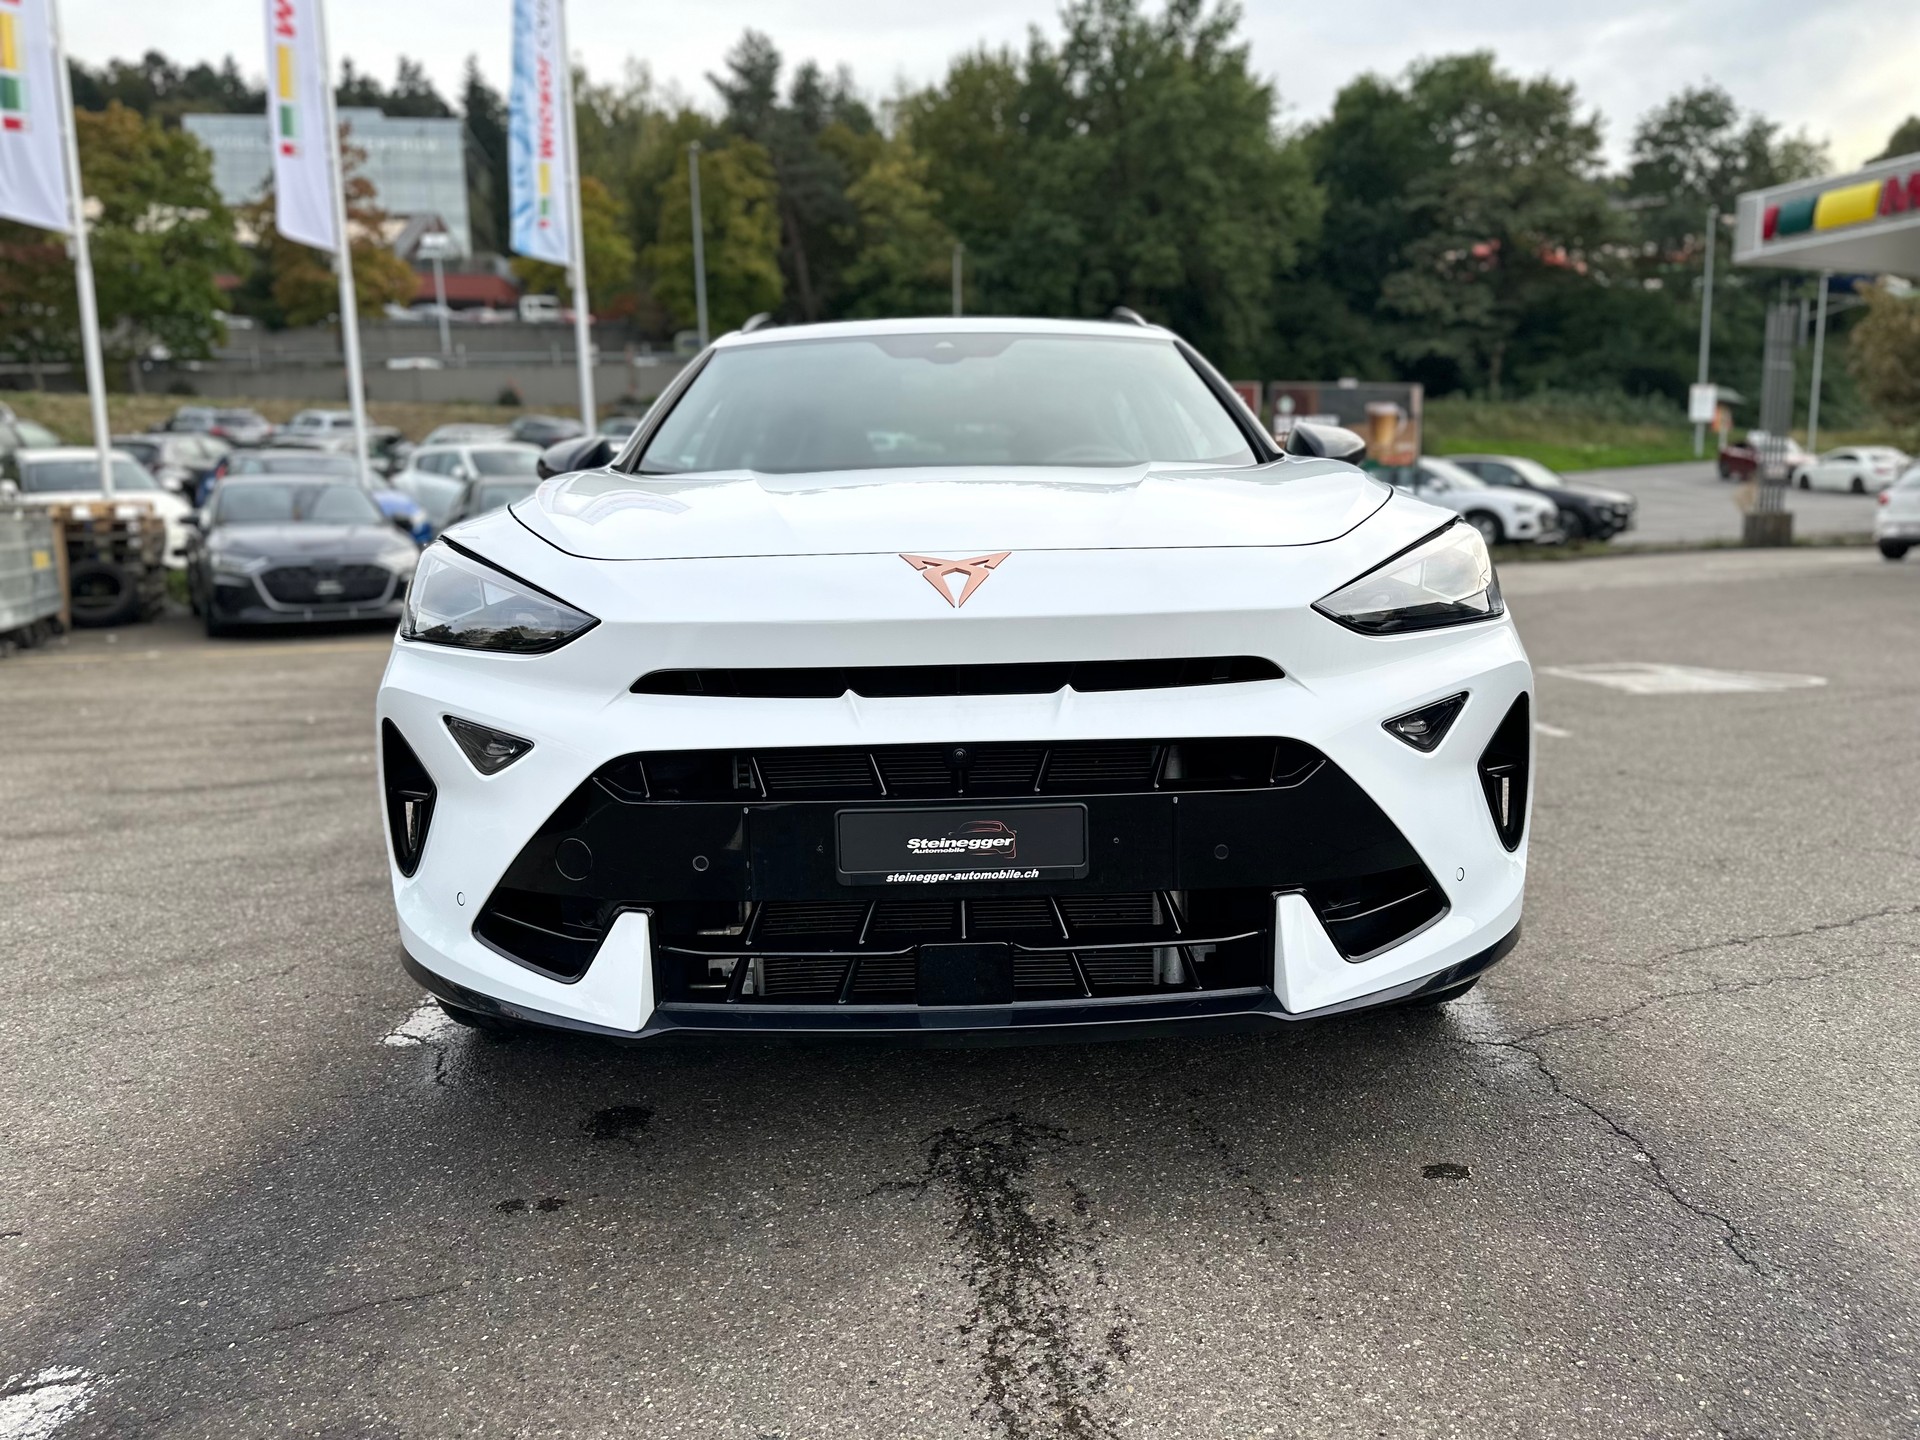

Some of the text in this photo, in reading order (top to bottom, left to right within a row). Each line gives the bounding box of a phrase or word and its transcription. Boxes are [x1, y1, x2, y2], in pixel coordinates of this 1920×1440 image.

[906, 836, 1014, 850] Steinegger
[911, 847, 966, 855] Automobile
[885, 868, 1040, 883] steinegger-automobile.ch
